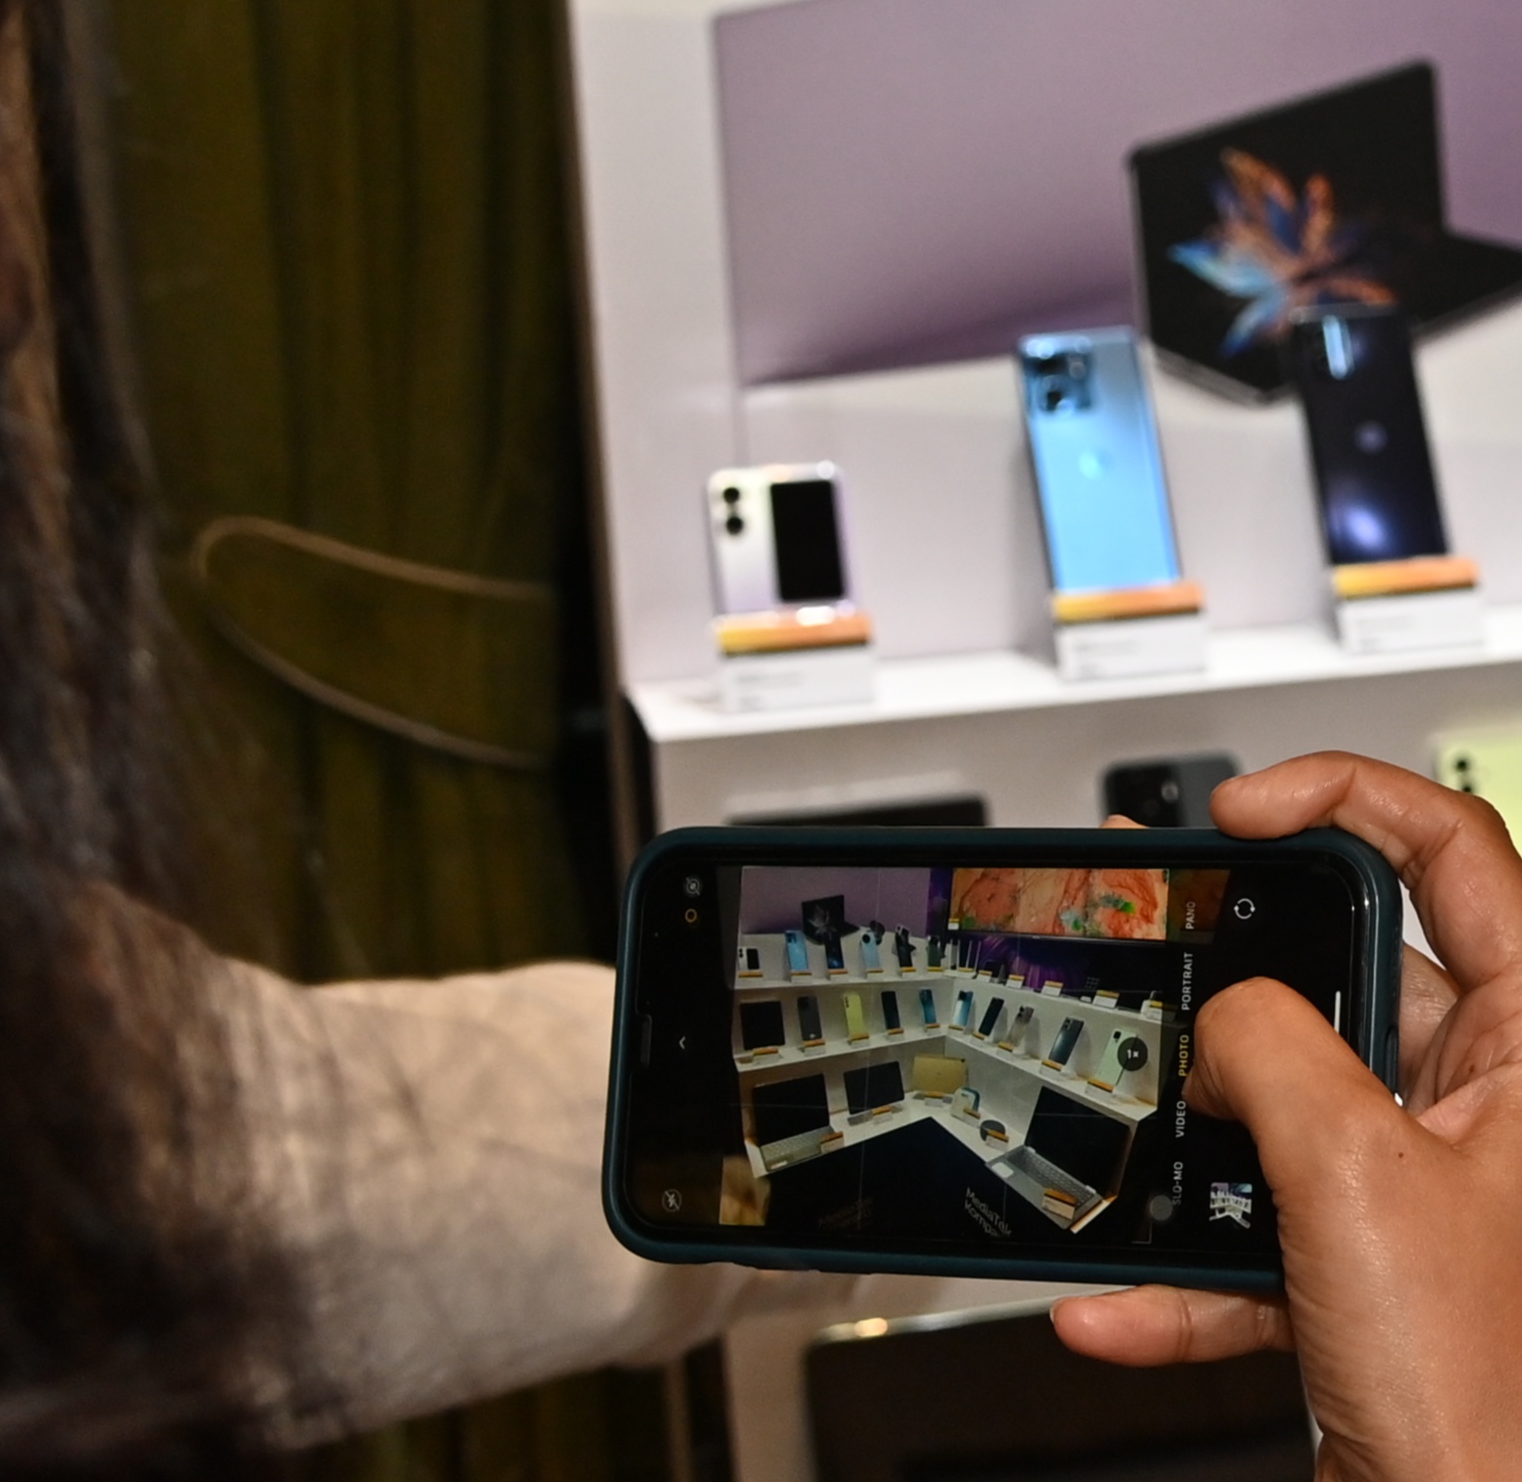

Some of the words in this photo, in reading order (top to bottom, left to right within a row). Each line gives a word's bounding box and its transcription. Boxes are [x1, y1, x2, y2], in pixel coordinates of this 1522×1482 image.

[1185, 901, 1196, 929] PANO
[1181, 952, 1193, 1010] PORTRAIT
[1179, 1034, 1189, 1077] PHOTO
[1176, 1100, 1186, 1138] VIDEO
[1172, 1161, 1183, 1205] SLO-MO
